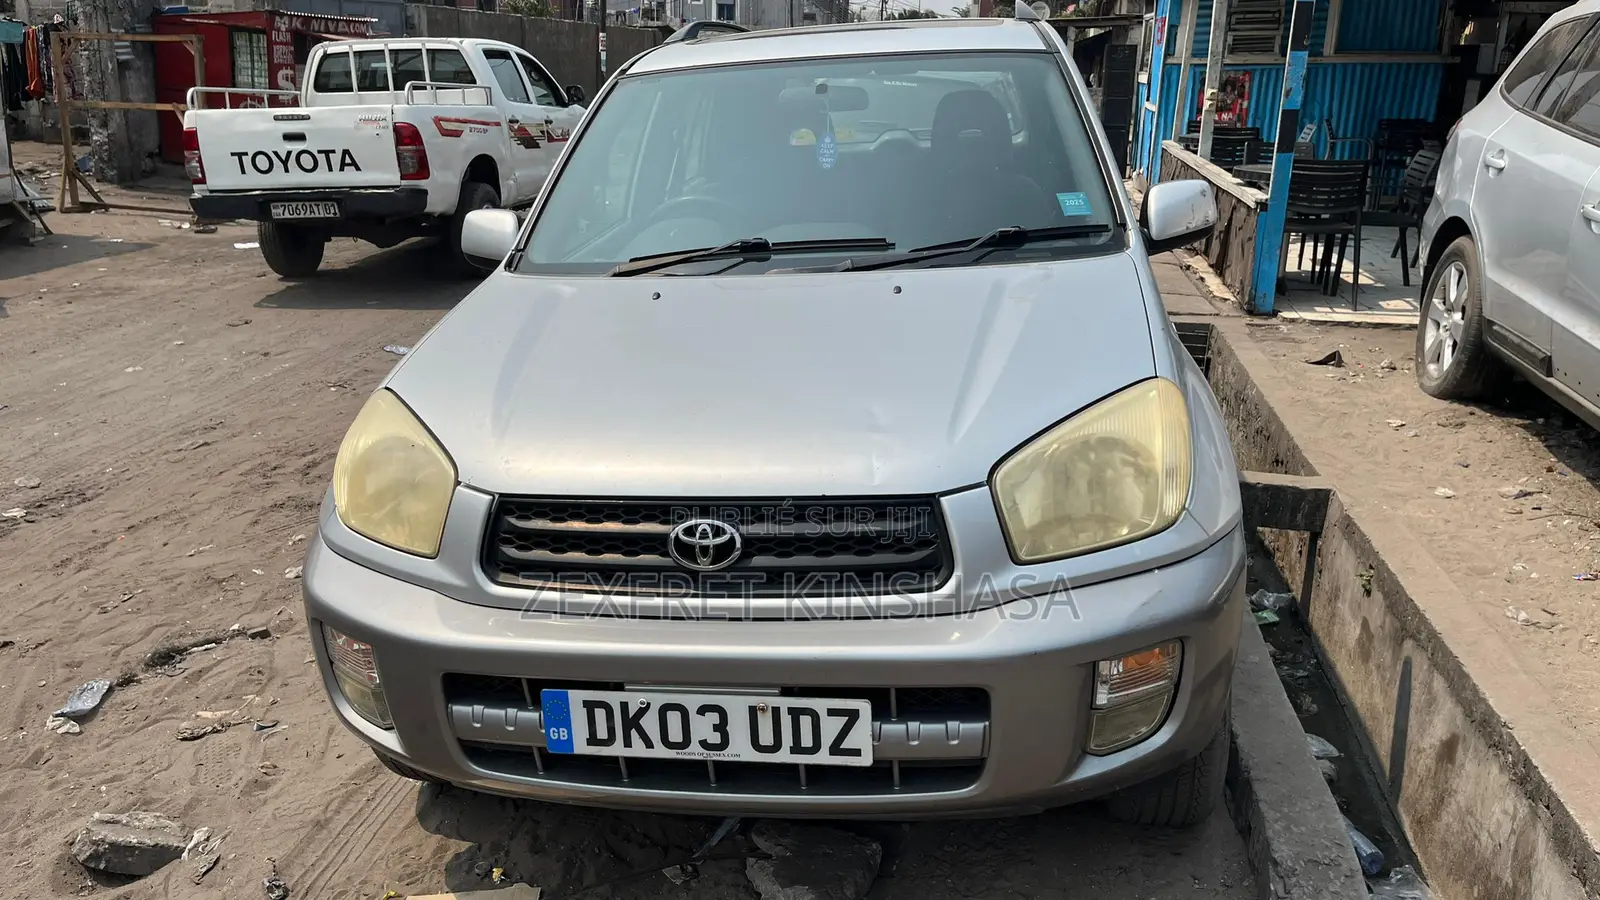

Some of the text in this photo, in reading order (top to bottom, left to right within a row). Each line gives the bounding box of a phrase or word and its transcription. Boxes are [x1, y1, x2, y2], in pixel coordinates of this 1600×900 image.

[230, 149, 362, 175] TOYOTA
[549, 727, 568, 740] GB
[582, 699, 862, 757] DK03 UDZ
